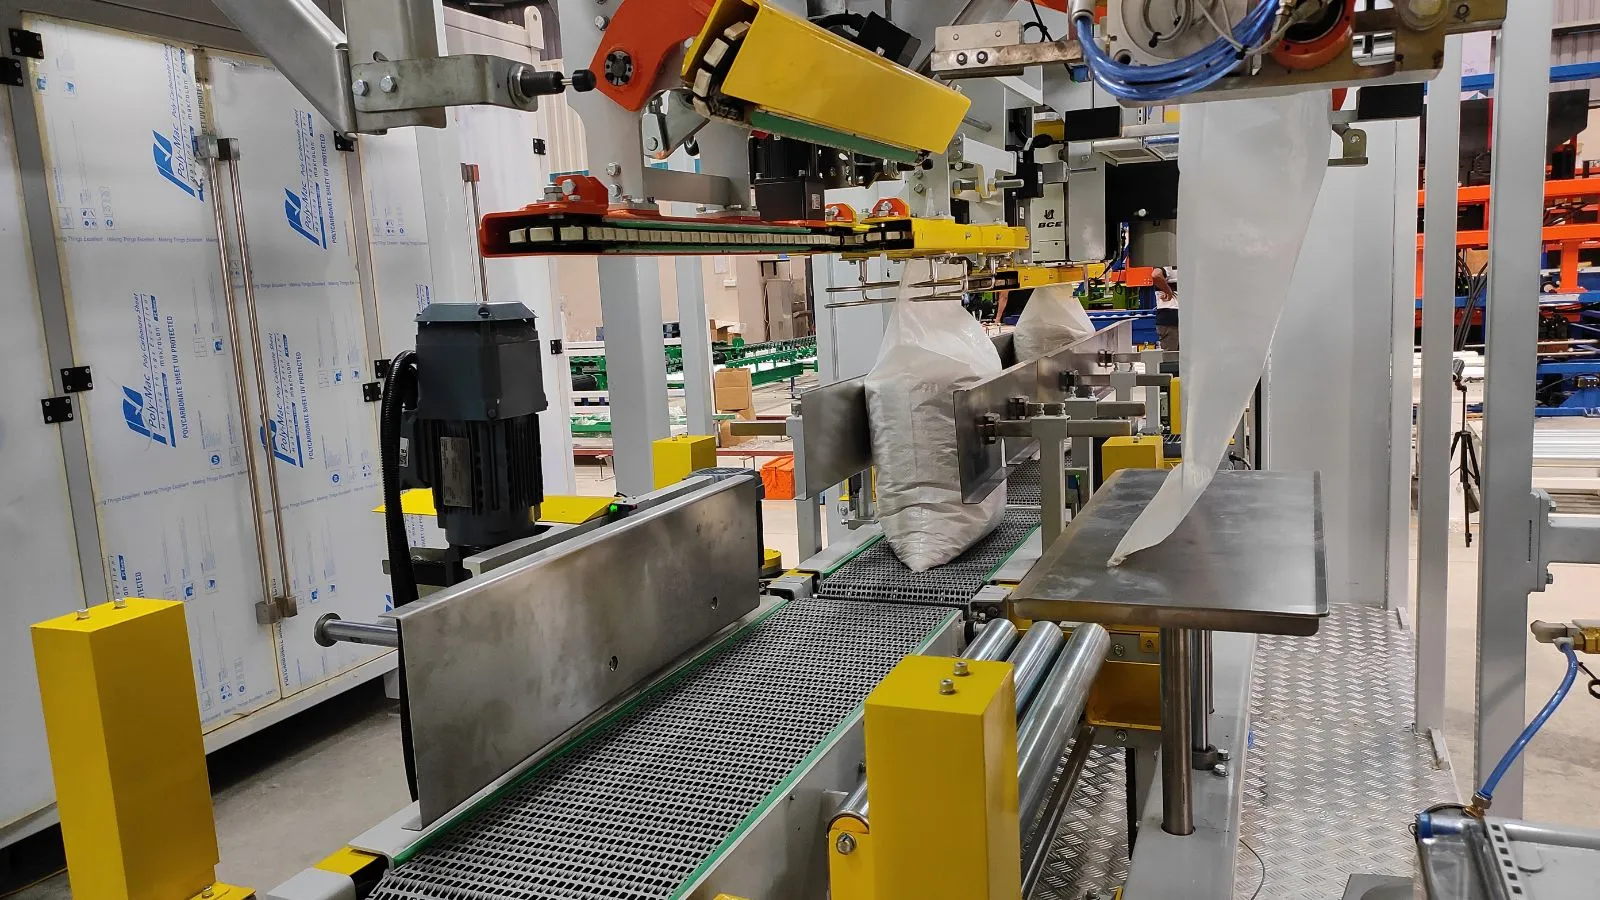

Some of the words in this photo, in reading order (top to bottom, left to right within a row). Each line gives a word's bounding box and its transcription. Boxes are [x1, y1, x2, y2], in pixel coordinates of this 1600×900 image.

[173, 123, 186, 179] Poly-Mac
[319, 133, 328, 167] PROTECTED
[301, 181, 312, 231] Poly-Mac
[324, 178, 332, 196] SHEET
[327, 197, 337, 244] POLYCARBONATE
[167, 315, 178, 353] PROTECTED
[172, 354, 179, 364] UV
[173, 365, 182, 385] SHEET
[296, 351, 304, 385] PROTECTED
[144, 373, 157, 429] Poly-Mac
[176, 387, 189, 439] POLYCARBONATE
[277, 403, 288, 452] Poly-Mac
